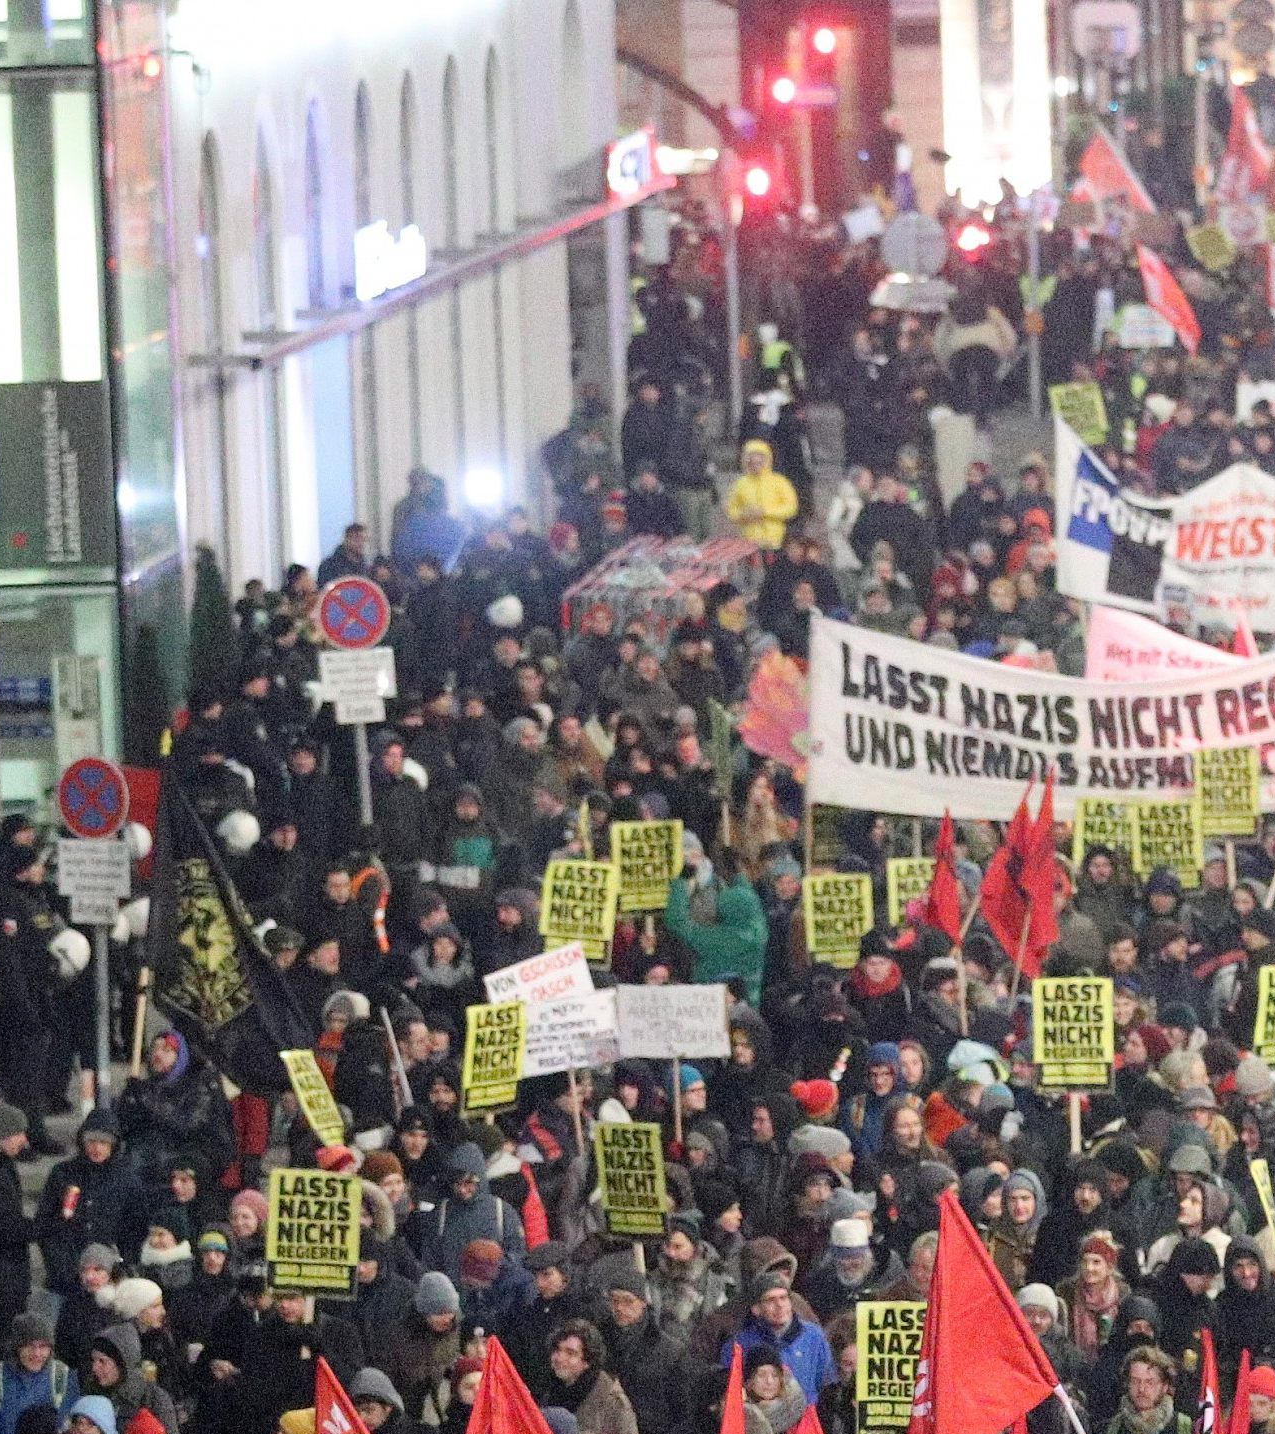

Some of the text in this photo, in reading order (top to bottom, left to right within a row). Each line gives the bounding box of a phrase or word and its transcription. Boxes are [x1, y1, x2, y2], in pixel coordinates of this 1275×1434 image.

[841, 642, 948, 716] LASST
[960, 684, 1078, 745] NAZIS
[1089, 694, 1205, 748] NICHT
[845, 713, 915, 770] UND
[1202, 750, 1251, 764] LASST
[1139, 804, 1192, 820] LASST
[620, 826, 673, 843] LASST
[1140, 823, 1194, 837] NAZIS
[1140, 841, 1195, 857] NICHT
[554, 864, 609, 882] LASST
[552, 884, 606, 901] NAZIS
[812, 880, 862, 896] LASST
[552, 902, 603, 921] NICHT
[1043, 984, 1103, 1001] LASST
[476, 1006, 521, 1028] LASST
[1043, 1005, 1103, 1022] NAZIS
[475, 1027, 520, 1048] NAZIS
[1043, 1026, 1104, 1044] NICHT
[474, 1048, 519, 1068] NICHT
[601, 1128, 651, 1148] LASST
[605, 1150, 656, 1170] NAZIS
[280, 1175, 351, 1198] LASST
[606, 1172, 656, 1192] NICHT
[279, 1201, 350, 1221] NAZIS
[278, 1223, 350, 1244] NICHT
[277, 1245, 348, 1260] REGIEREN
[868, 1308, 926, 1331] LASS
[868, 1333, 920, 1355] NAZ
[868, 1383, 913, 1397] REGIE
